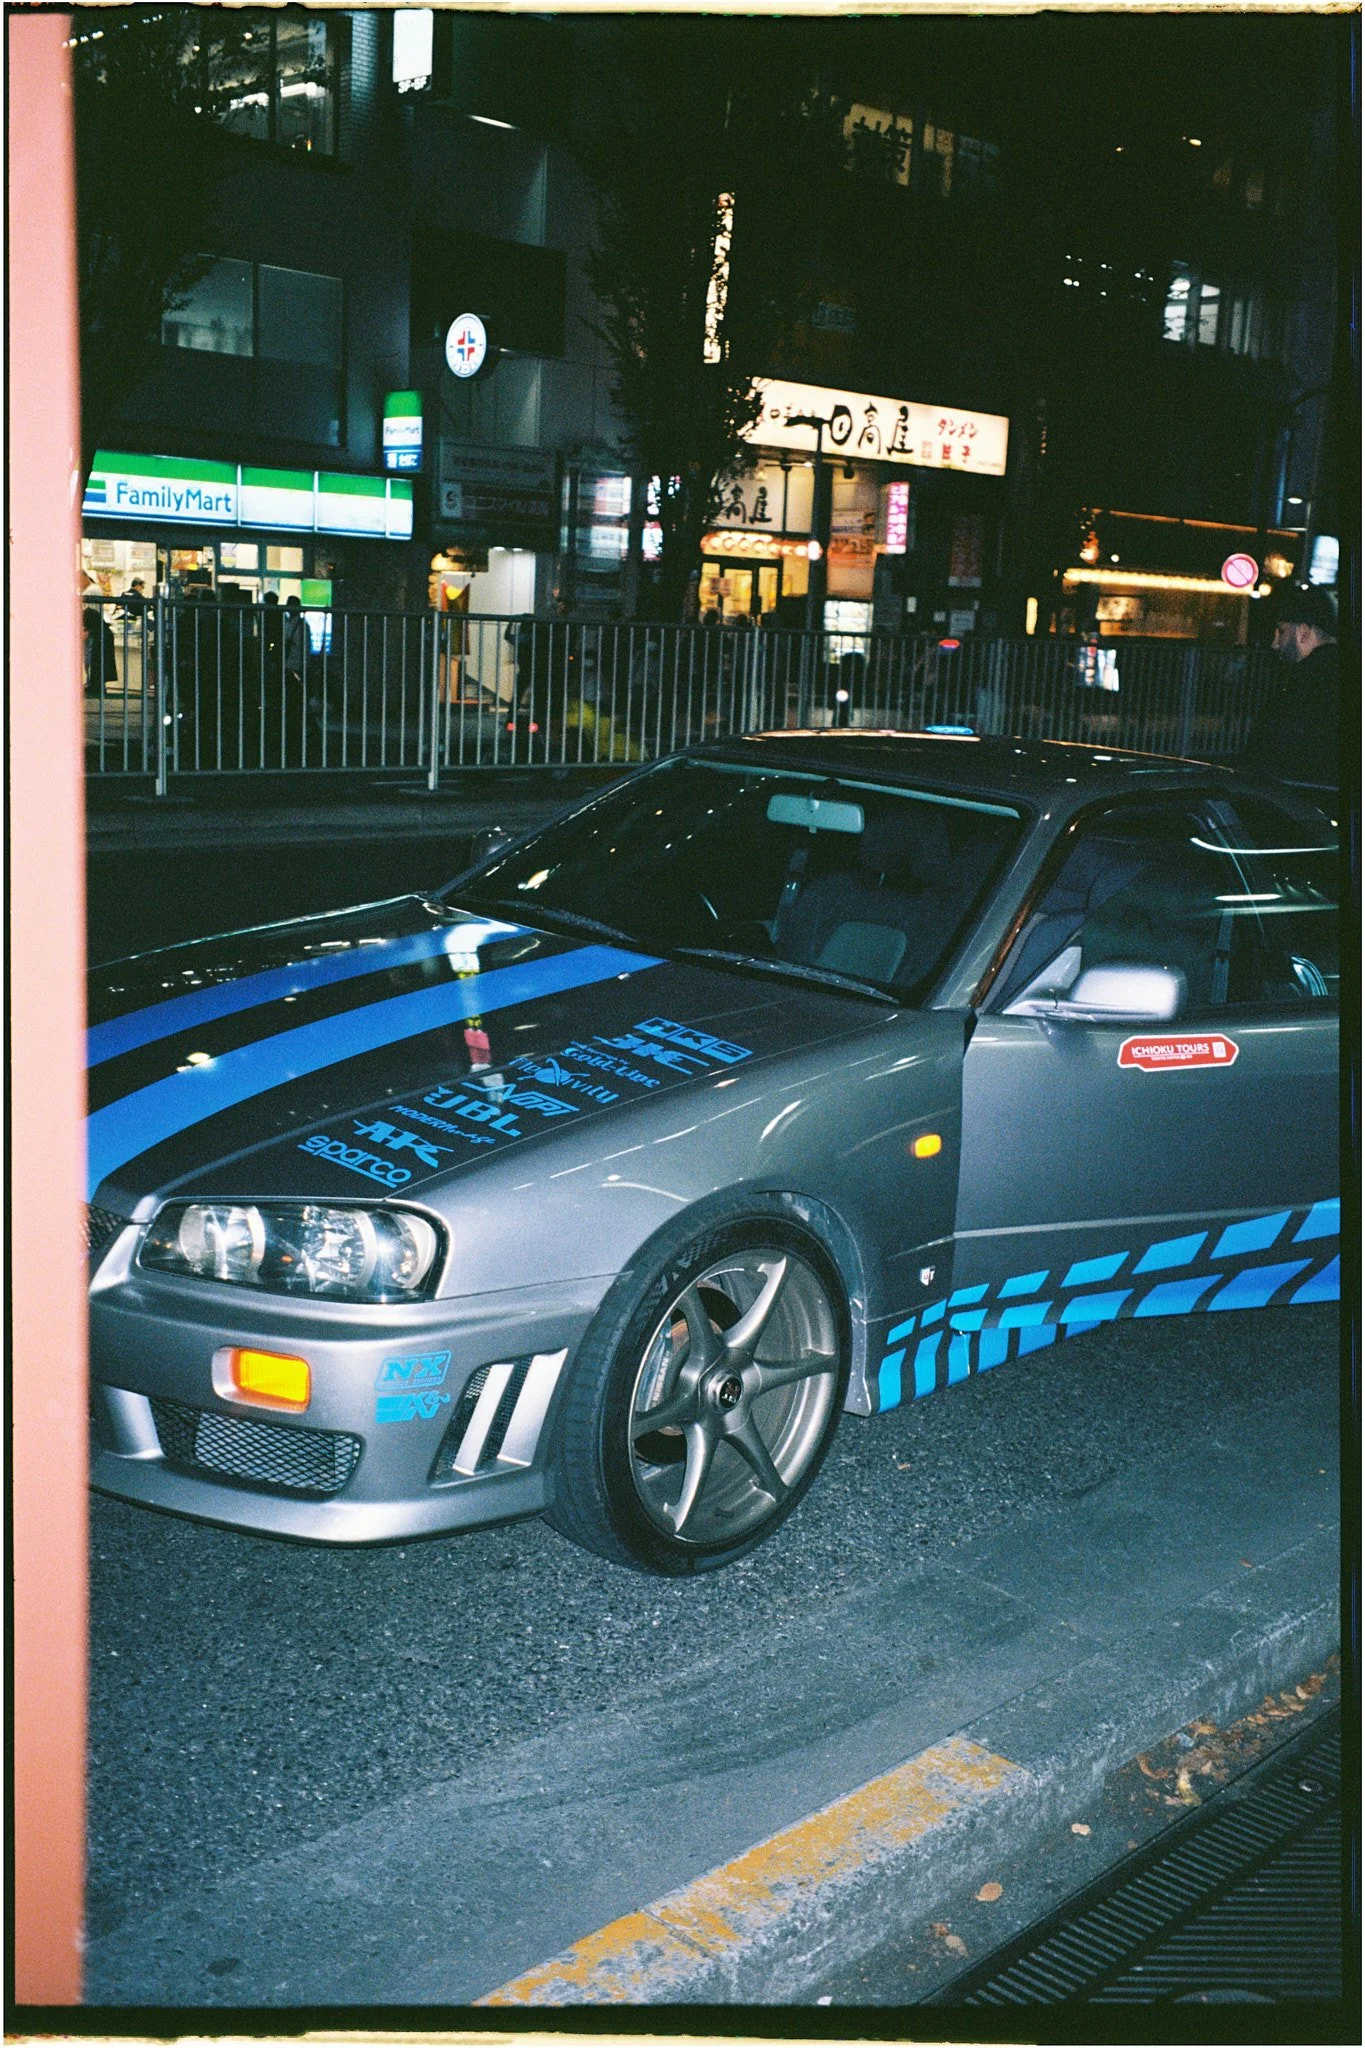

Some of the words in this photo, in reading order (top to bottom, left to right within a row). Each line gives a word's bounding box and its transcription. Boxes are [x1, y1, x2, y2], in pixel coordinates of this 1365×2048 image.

[829, 400, 914, 456] 日高屋
[937, 417, 979, 440] タンメン
[115, 480, 233, 513] FamilyMart
[635, 1017, 753, 1063] HKS
[1131, 1045, 1174, 1056] ICHIOKU
[1175, 1042, 1210, 1054] TOURS
[423, 1093, 523, 1138] JBL
[304, 1135, 413, 1186] sparco
[382, 1355, 447, 1382] NX
